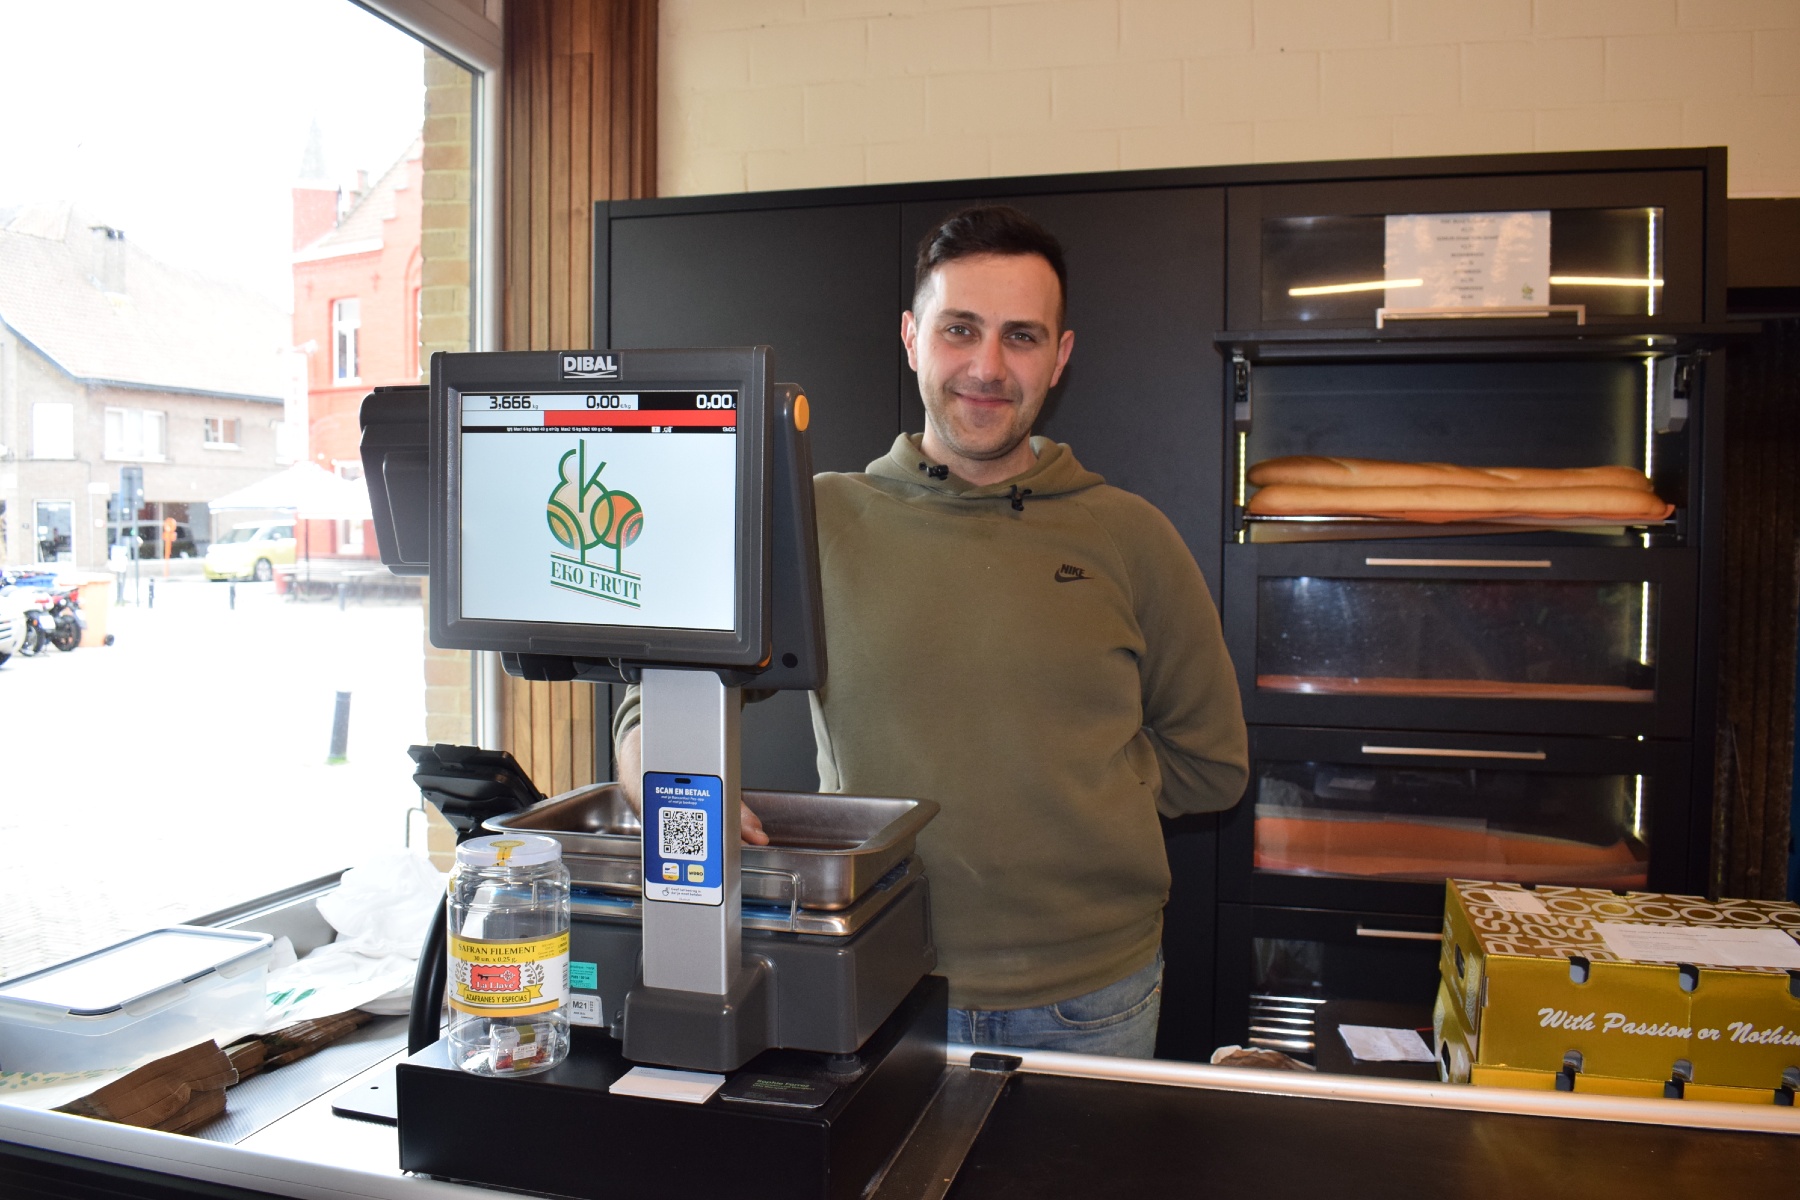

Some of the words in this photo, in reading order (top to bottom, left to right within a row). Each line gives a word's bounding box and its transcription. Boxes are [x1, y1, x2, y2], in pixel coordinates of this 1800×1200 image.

[563, 355, 618, 372] DIBAL
[489, 395, 531, 410] 3,666
[586, 395, 620, 409] 0,00
[696, 394, 733, 409] 0,00
[1060, 563, 1086, 578] NIKE
[551, 560, 584, 585] EKO
[590, 570, 641, 600] FRUIT
[655, 786, 674, 795] SCAN
[674, 788, 684, 796] EN
[684, 788, 711, 797] BETAAL
[1453, 878, 1537, 958] PASSION
[458, 943, 488, 955] SAFRAN
[490, 945, 537, 955] FILEMENT
[476, 981, 488, 989] La
[466, 993, 495, 1003] AZAFRANES
[496, 995, 501, 1003] Y
[502, 994, 528, 1003] ESPECIAS
[572, 1000, 587, 1009] M21
[1538, 1007, 1596, 1031] With
[1602, 1012, 1693, 1039] Passion
[1697, 1027, 1721, 1041] or
